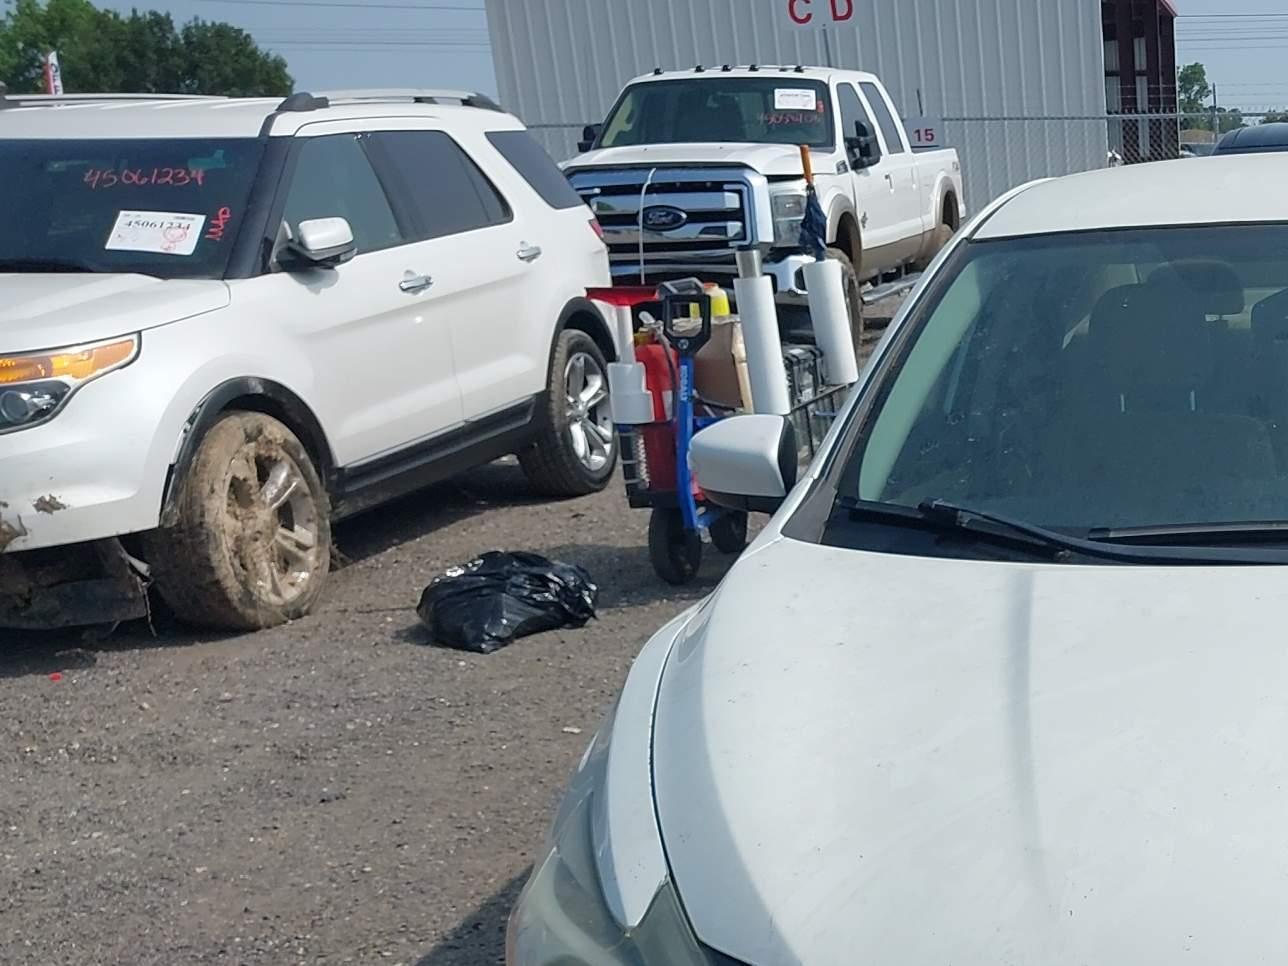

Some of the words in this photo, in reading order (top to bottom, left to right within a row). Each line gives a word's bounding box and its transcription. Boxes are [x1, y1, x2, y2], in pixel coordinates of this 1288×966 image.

[789, 0, 812, 24] C
[830, 0, 853, 21] D
[914, 128, 935, 142] 15
[83, 167, 205, 189] 45061234
